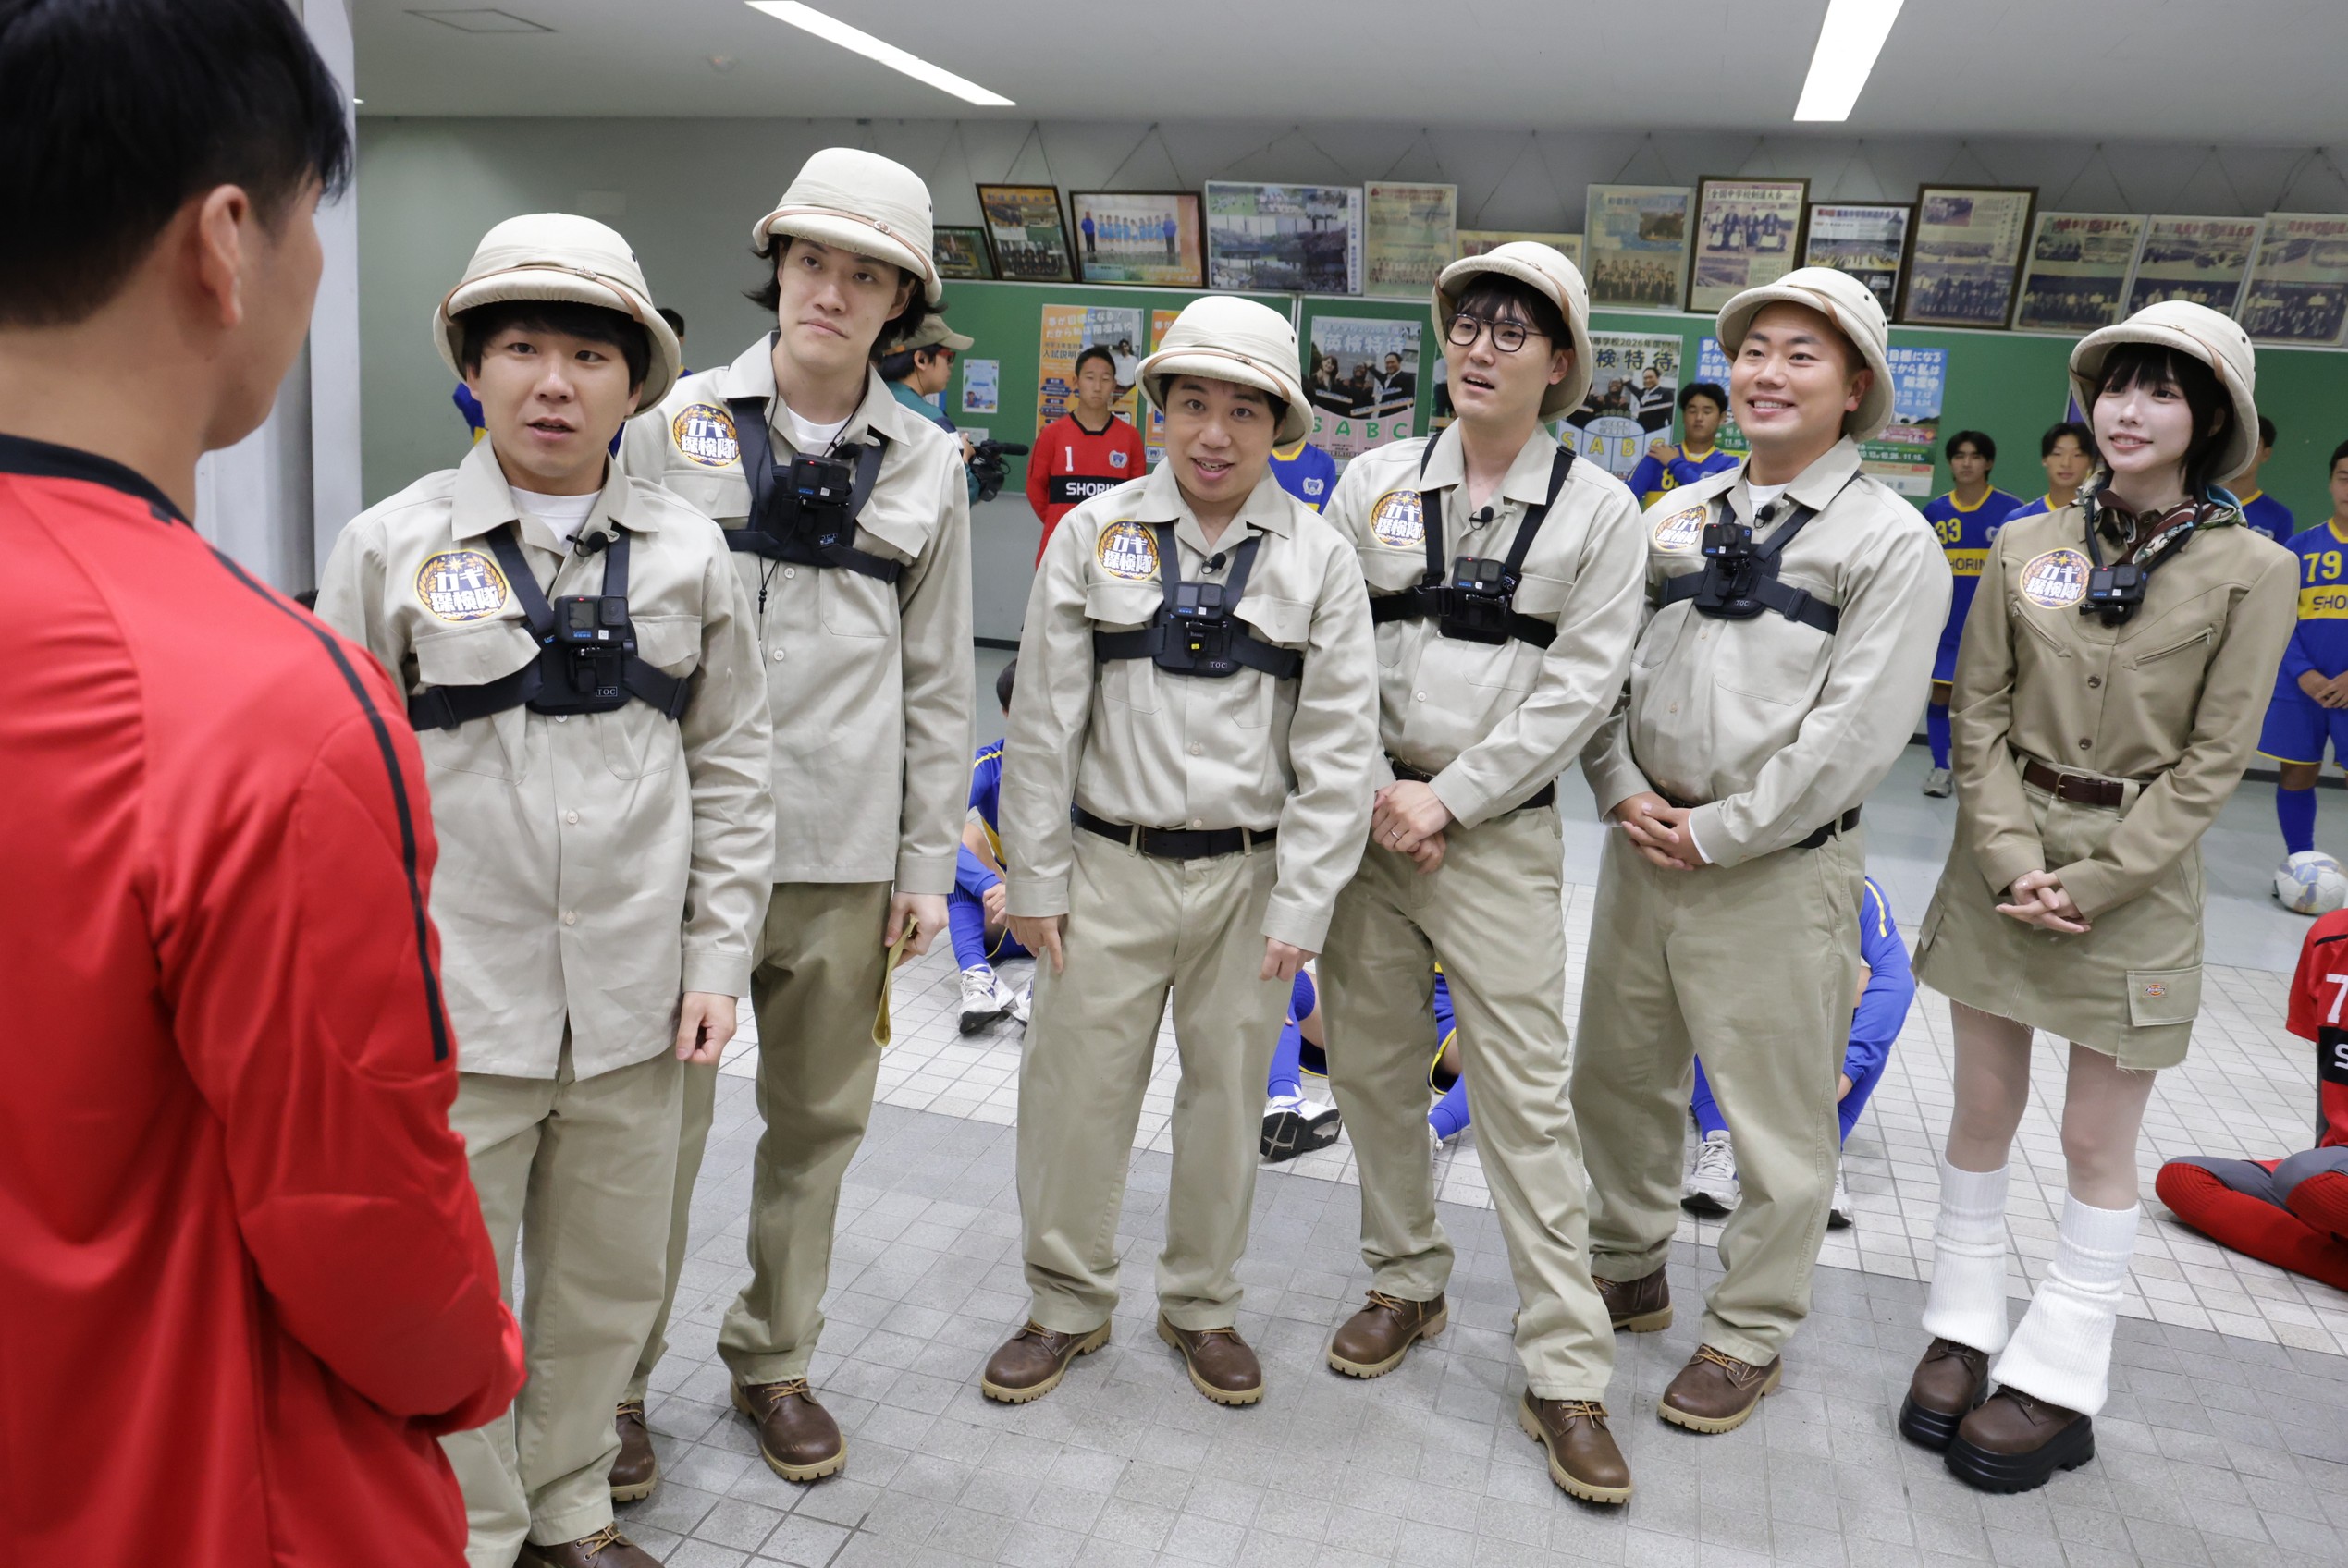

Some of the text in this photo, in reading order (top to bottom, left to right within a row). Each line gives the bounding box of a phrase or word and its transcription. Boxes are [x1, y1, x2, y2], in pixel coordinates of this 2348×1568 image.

[1324, 332, 1406, 354] 英検特待
[1043, 349, 1080, 360] 入試説明
[1887, 349, 1941, 363] 目標になる
[687, 417, 727, 438] カギ
[1335, 420, 1351, 436] A
[1365, 422, 1380, 439] B
[1393, 423, 1408, 439] C
[681, 435, 737, 459] 探検隊
[1588, 435, 1604, 455] A
[1620, 437, 1636, 457] B
[1064, 446, 1074, 472] 1
[1065, 482, 1119, 496] SHORI
[1386, 502, 1422, 521] カギ
[1375, 516, 1423, 539] 探検隊
[1671, 516, 1702, 532] カギ
[1935, 517, 1961, 545] 33
[1112, 534, 1149, 554] カギ
[1656, 528, 1700, 545] 探検隊
[1103, 549, 1153, 572] 探検隊
[2303, 550, 2342, 582] 79
[434, 565, 484, 592] カギ
[2039, 564, 2081, 582] カギ
[2025, 576, 2082, 599] 探検隊
[429, 585, 501, 612] 探検隊
[597, 688, 616, 696] TOC
